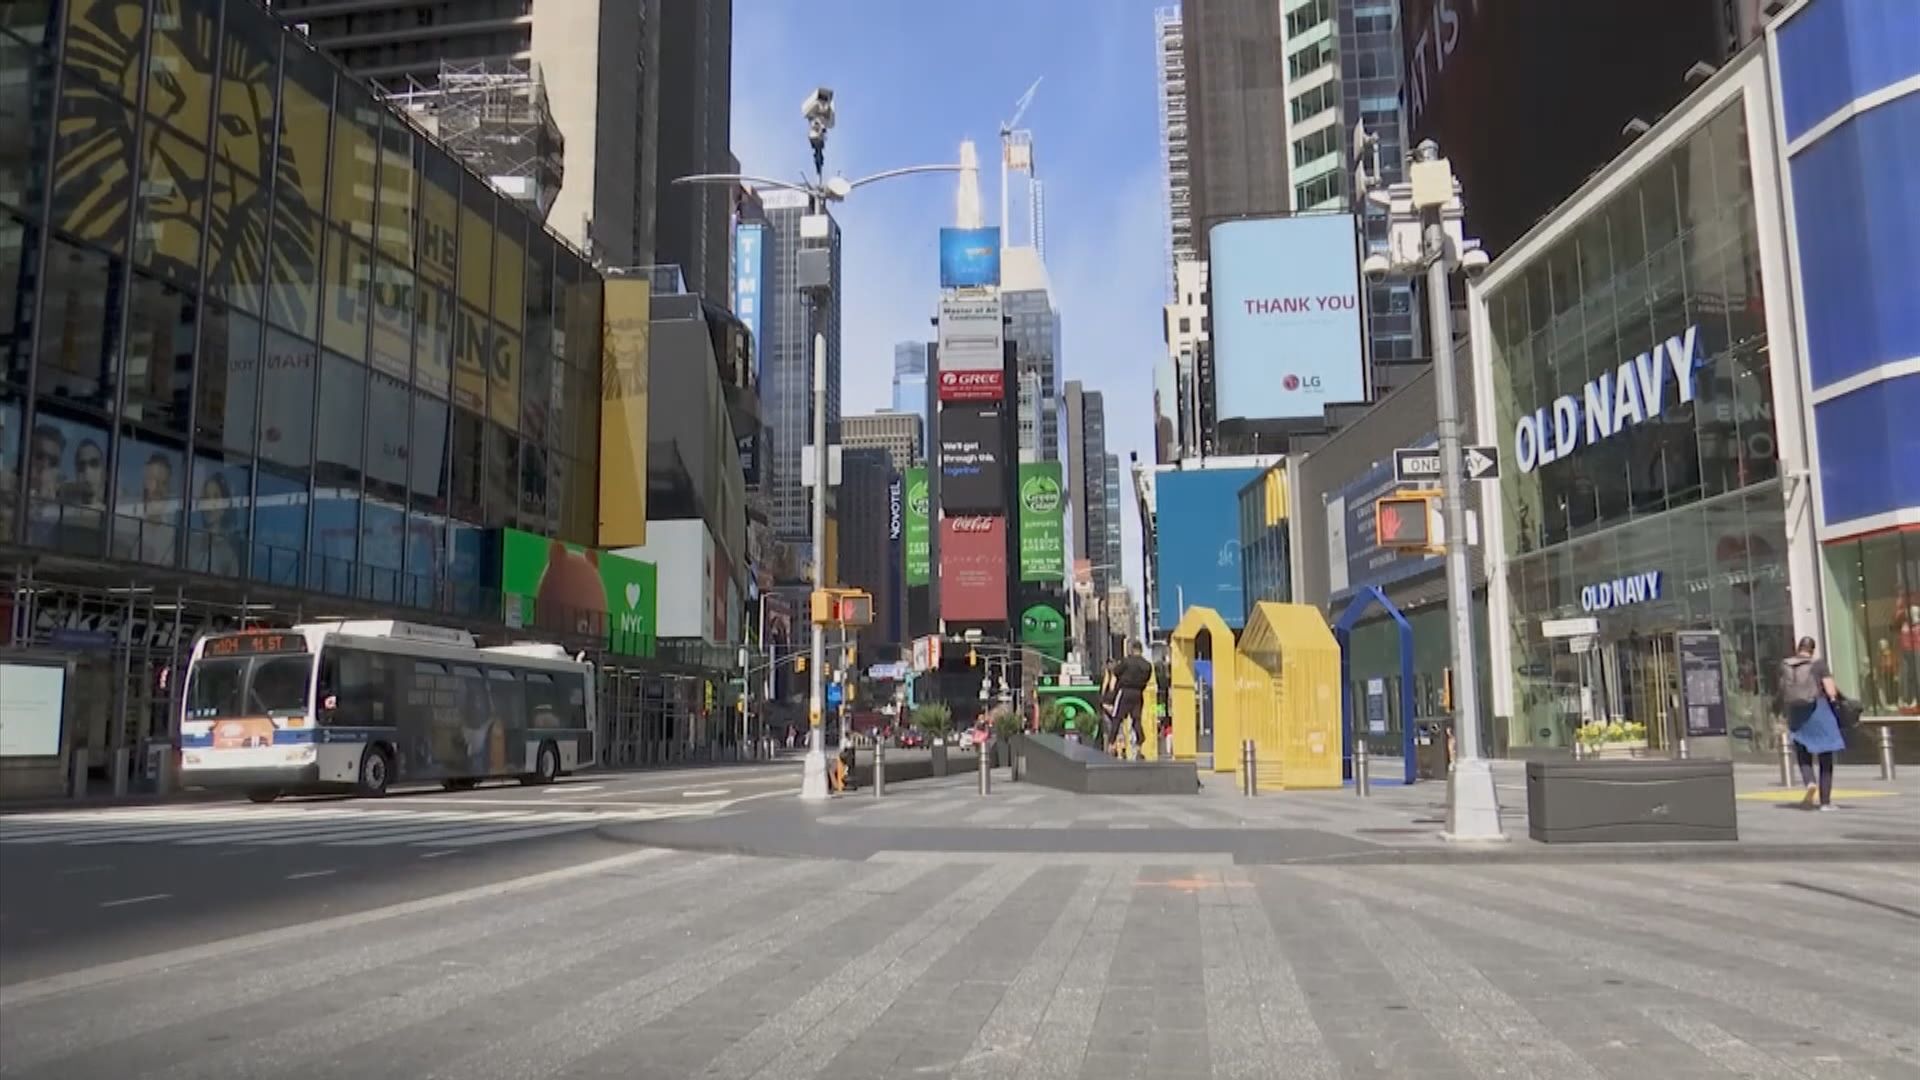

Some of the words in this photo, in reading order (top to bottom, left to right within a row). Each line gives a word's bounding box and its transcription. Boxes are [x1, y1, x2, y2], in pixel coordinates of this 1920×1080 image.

[1245, 297, 1311, 315] THANK
[1316, 294, 1356, 310] YOU
[958, 373, 1001, 385] GREE
[1303, 376, 1321, 388] LG
[1515, 394, 1579, 475] OLD
[1583, 325, 1698, 446] NAVY
[943, 454, 978, 464] through
[1410, 458, 1441, 473] ONE
[889, 479, 900, 540] NOVOTEL
[1582, 582, 1613, 612] OLD
[1612, 571, 1659, 607] NAVY
[268, 636, 283, 650] ST
